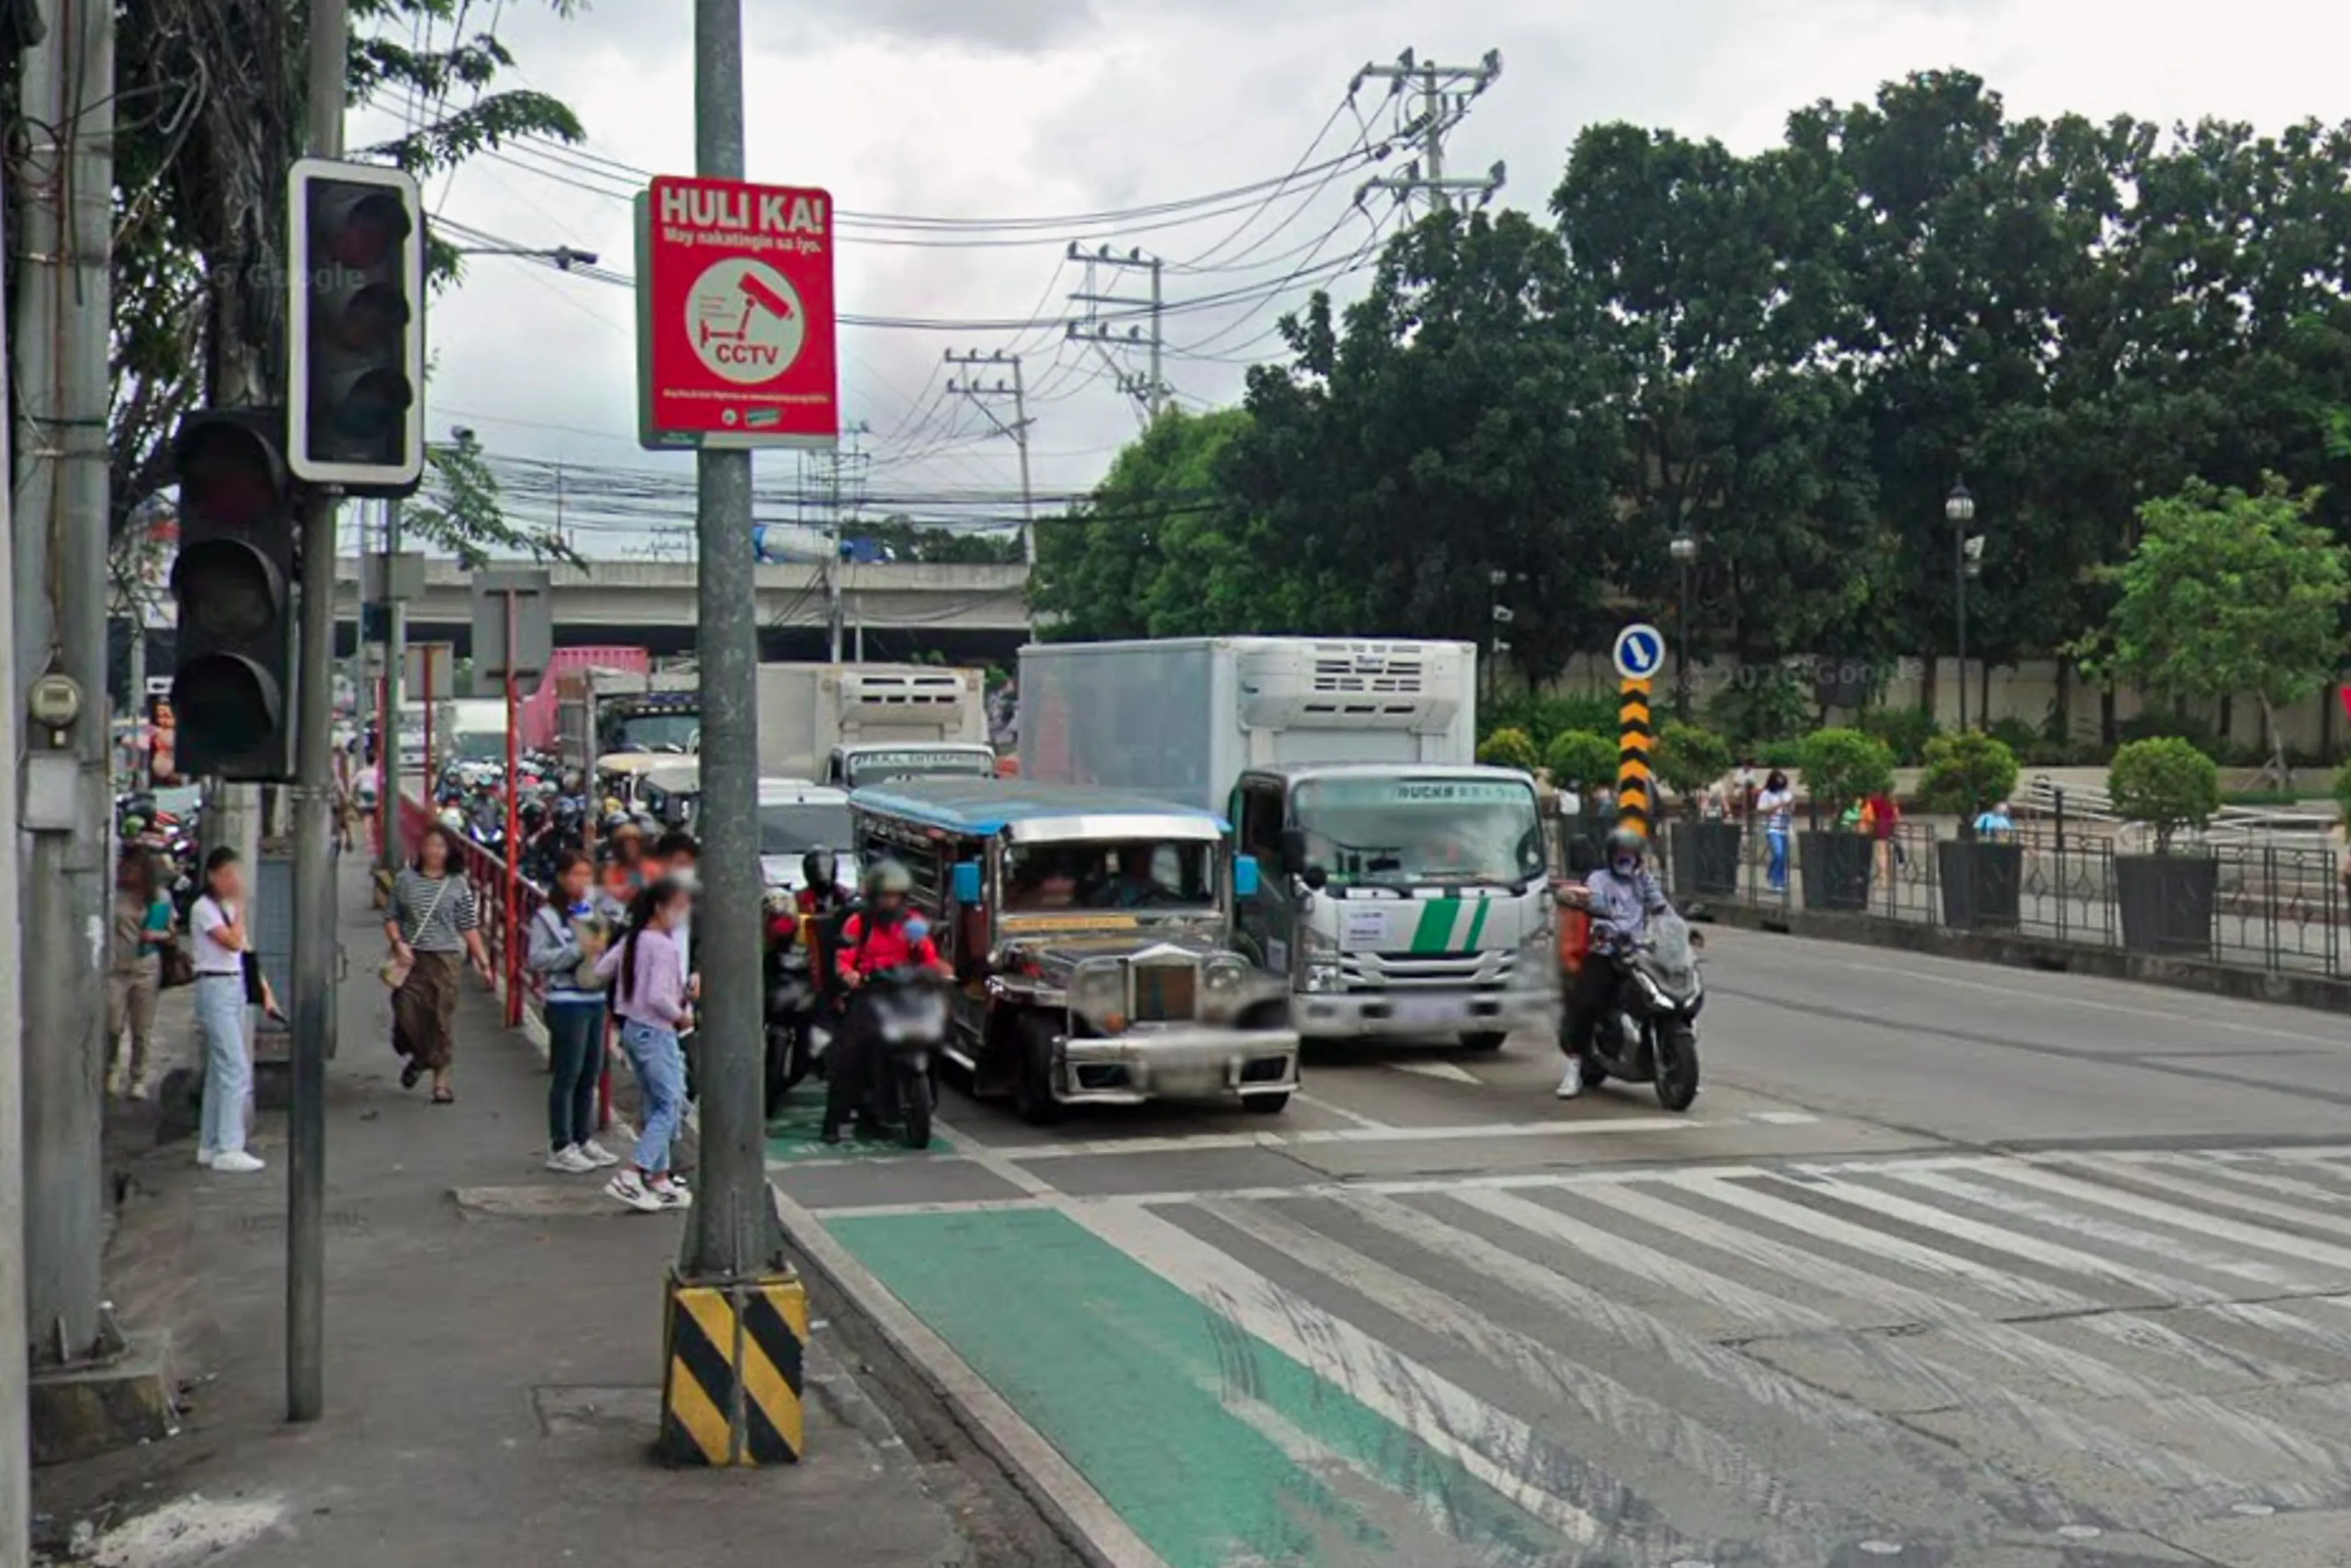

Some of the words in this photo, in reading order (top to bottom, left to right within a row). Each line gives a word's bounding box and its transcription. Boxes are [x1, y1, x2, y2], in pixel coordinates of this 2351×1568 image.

[661, 186, 750, 230] HULI
[759, 193, 825, 234] KA!
[663, 225, 694, 248] May
[697, 230, 773, 252] nakatingin
[775, 238, 794, 250] sa
[716, 343, 779, 366] CCTV
